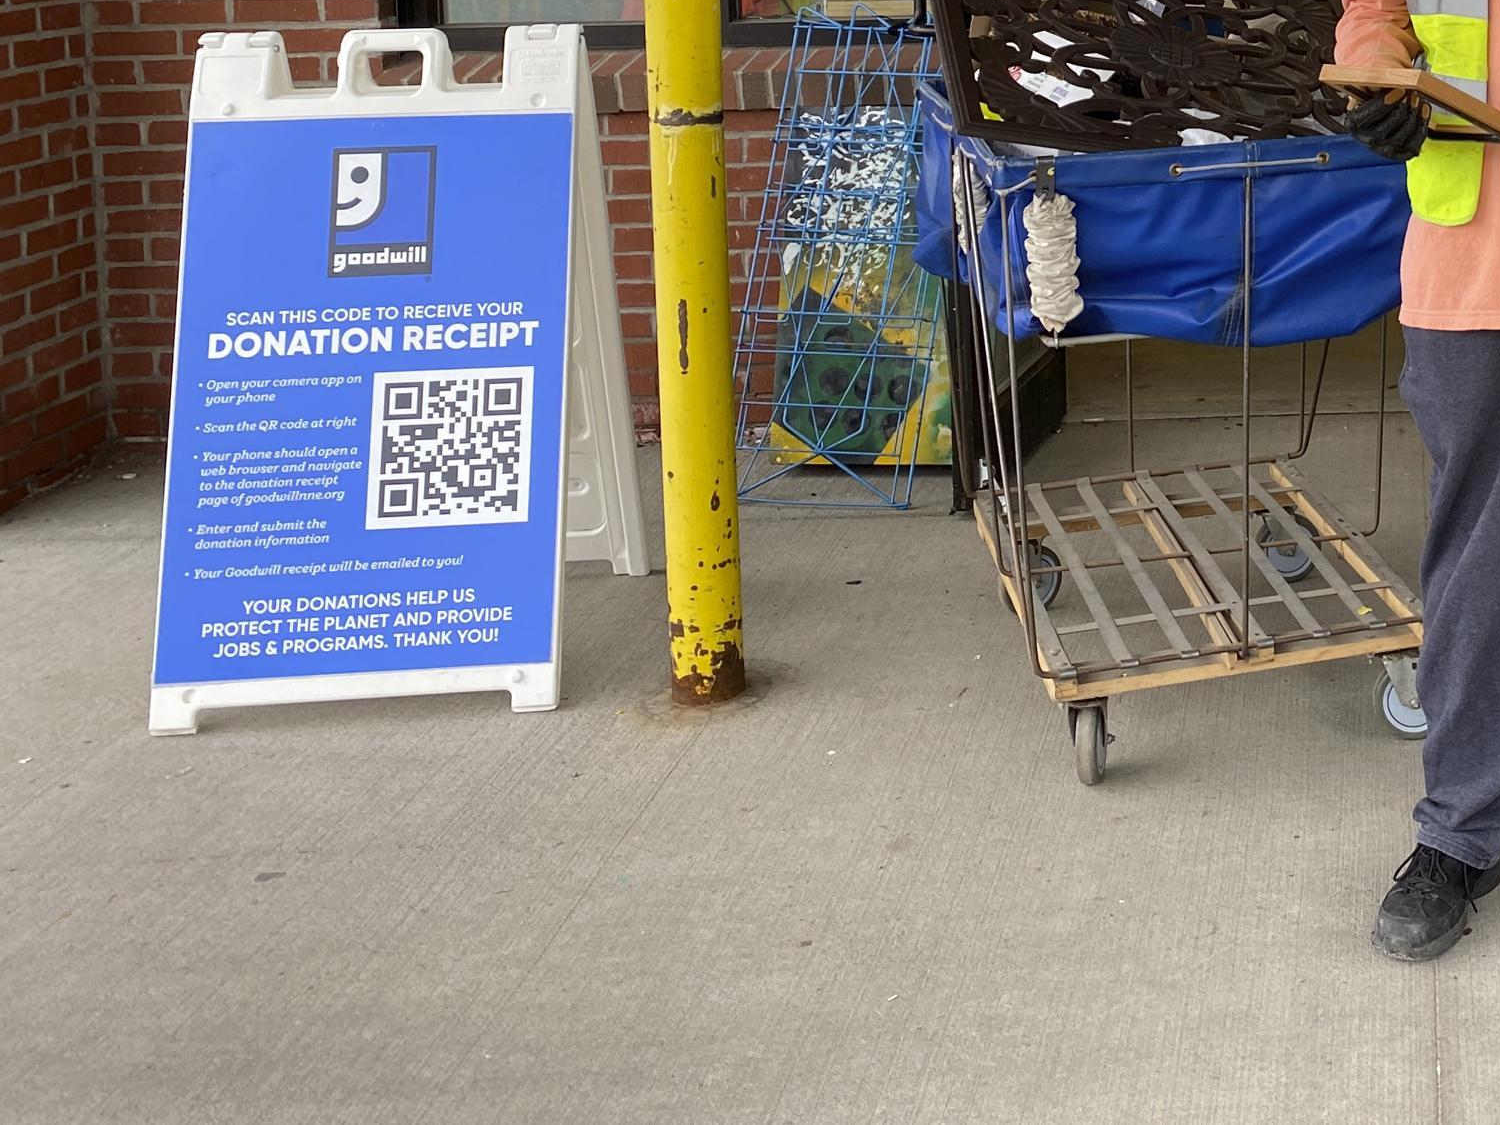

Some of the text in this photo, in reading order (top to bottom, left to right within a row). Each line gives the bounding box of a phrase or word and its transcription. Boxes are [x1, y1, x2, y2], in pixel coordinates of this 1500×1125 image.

[333, 246, 427, 273] goodwill
[226, 301, 524, 327] SCAN THIS CODE TO RECEIVE YOUR
[208, 320, 540, 359] DONATION RECEIPT
[206, 375, 362, 393] Open your camera app on
[204, 391, 277, 408] your phone
[203, 415, 358, 434] Scan the QR code at right
[202, 445, 359, 464] Your phone should open a
[200, 459, 363, 477] web browser and navigate
[199, 474, 339, 492] to the donation receipt
[197, 495, 229, 509] page
[230, 493, 246, 506] of
[196, 517, 328, 536] Enter and submit the
[195, 532, 330, 550] donation information
[194, 554, 464, 580] Your Goodwill receipt will be emailed to you!
[243, 587, 476, 615] YOUR DONATIONS HELP US
[201, 605, 513, 638] PROTECT THE PLANET AND PROVIDE
[213, 627, 499, 658] JOBS & PROGRAMS. THANK YOU!
